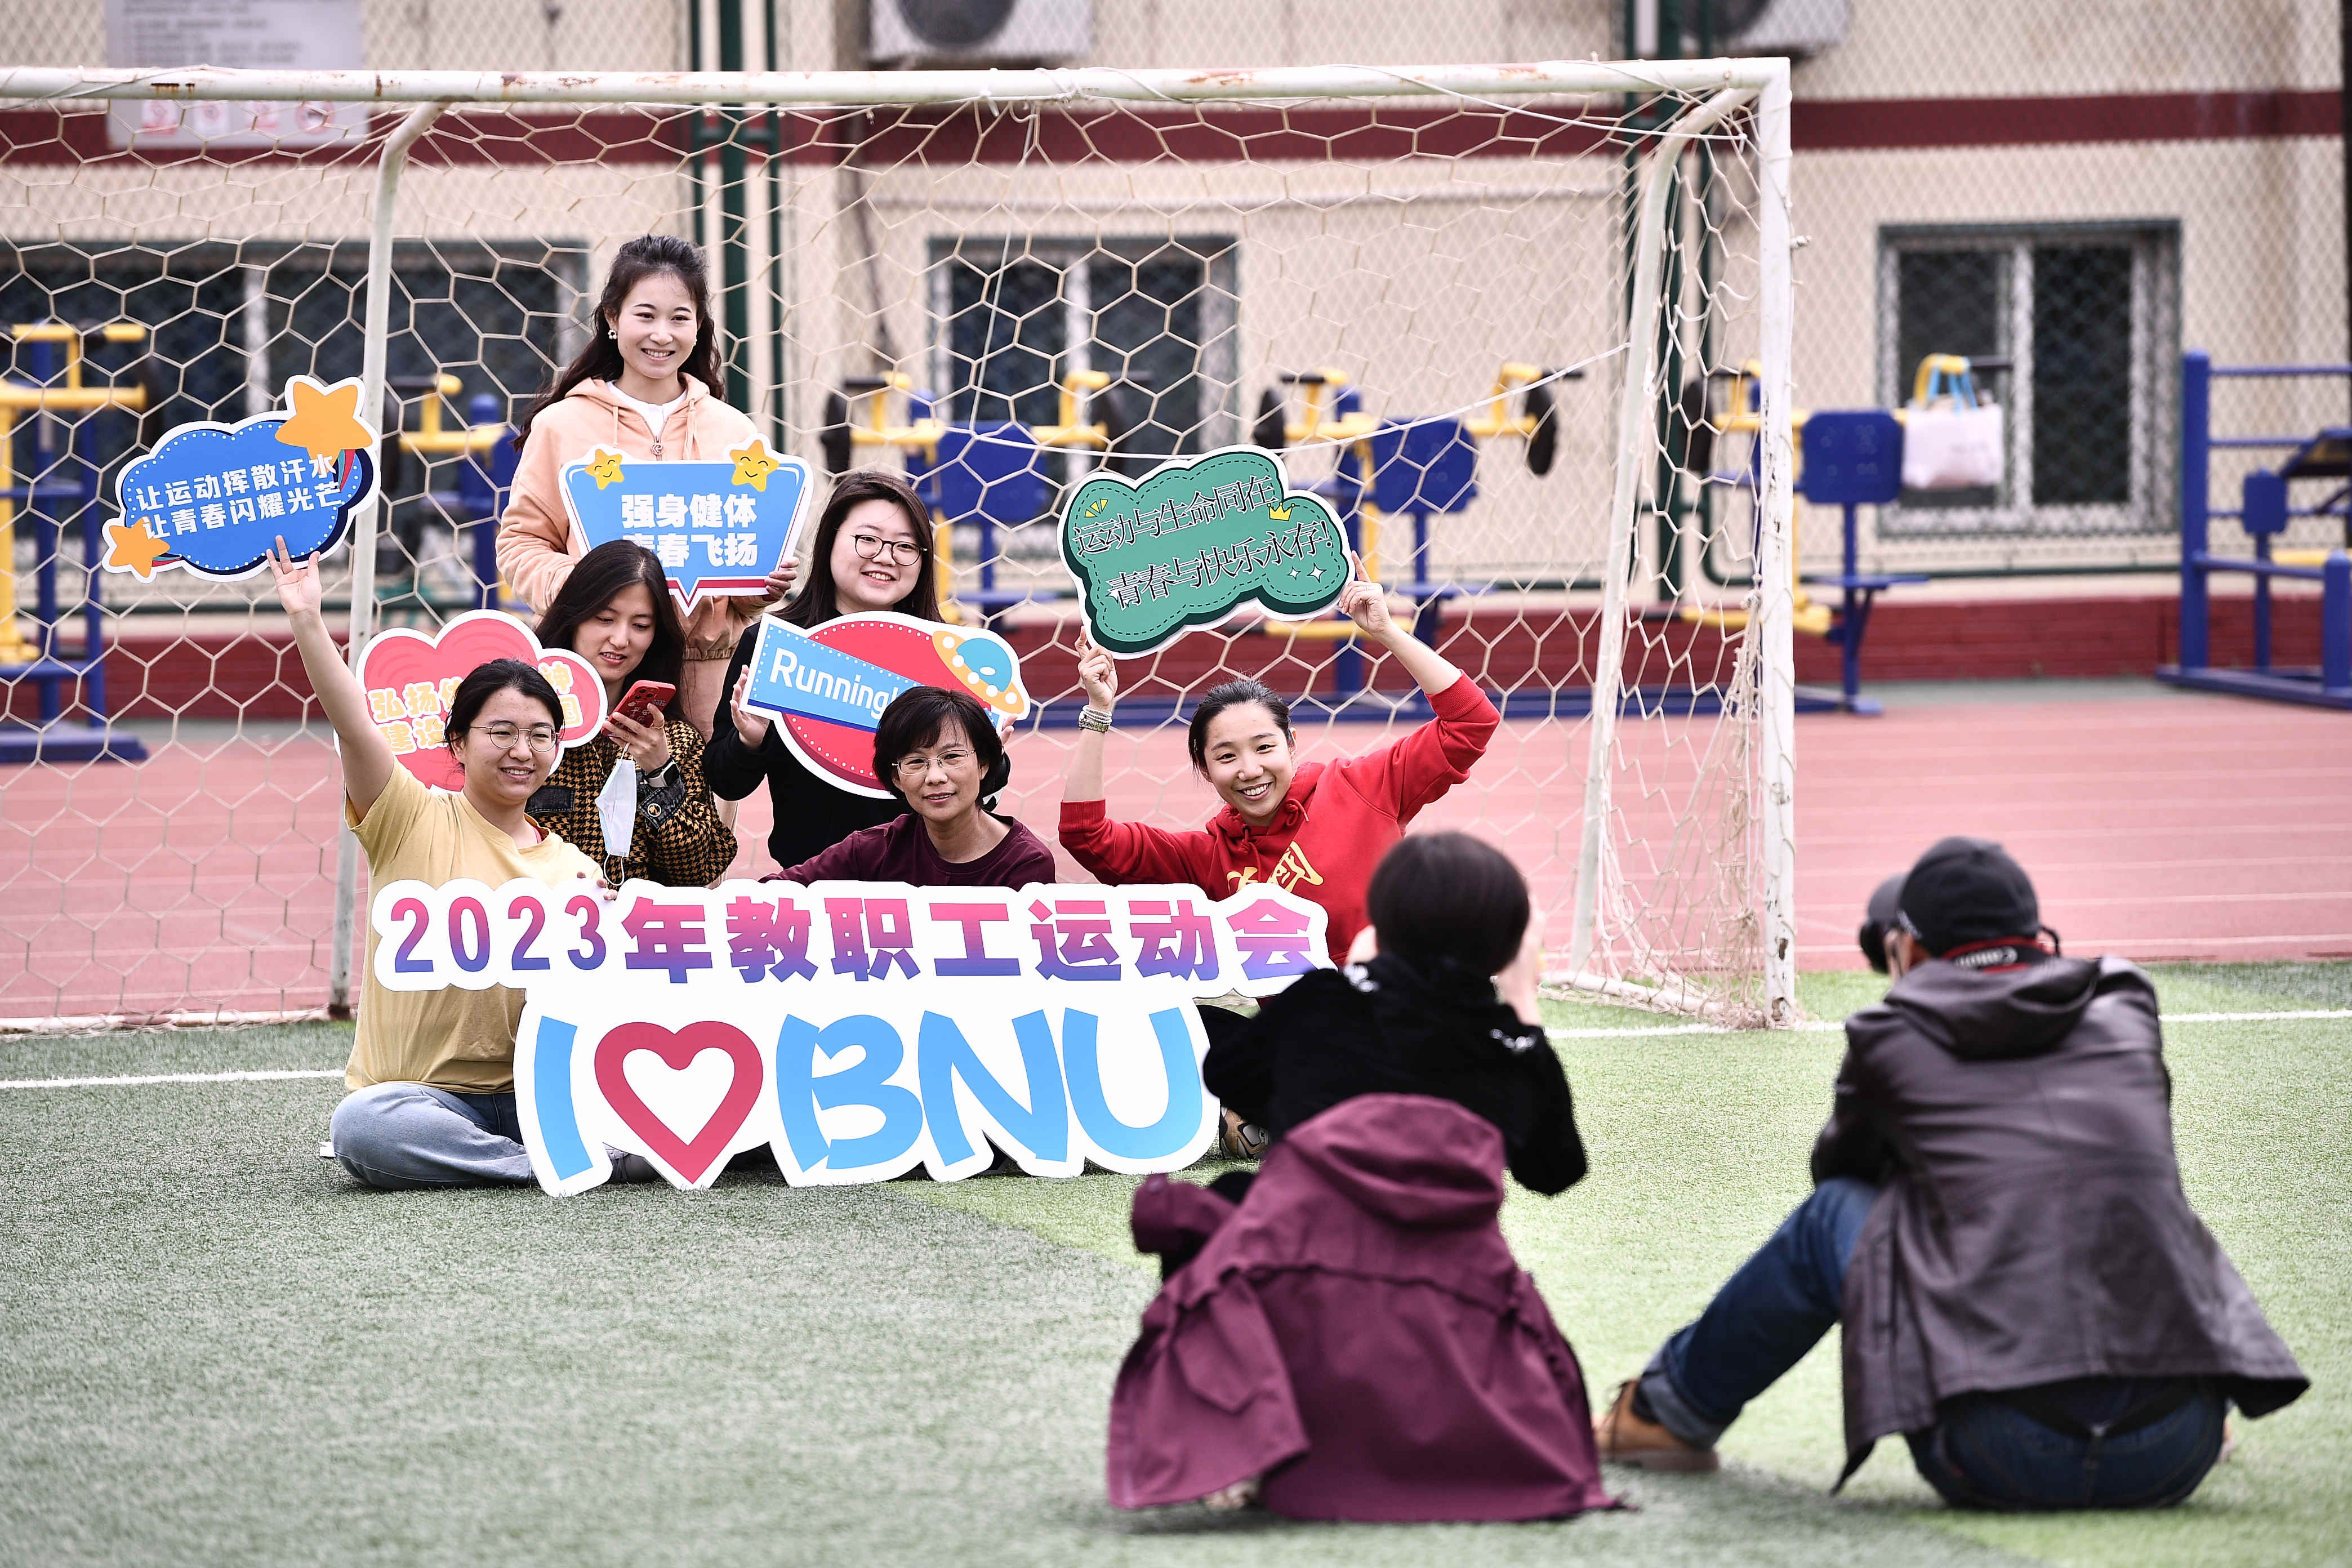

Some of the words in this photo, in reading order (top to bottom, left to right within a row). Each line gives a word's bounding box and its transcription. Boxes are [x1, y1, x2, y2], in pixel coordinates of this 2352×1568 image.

[135, 453, 337, 511] 让运动挥散汗水
[142, 482, 342, 540] 让青春闪耀光芒
[621, 493, 758, 528] 强身健体
[1071, 474, 1276, 556] 运动与生命同在
[1106, 519, 1332, 612] 青春与快乐永存!
[390, 895, 1317, 984] 2023年教职工运动会
[776, 1006, 1203, 1173] BNU
